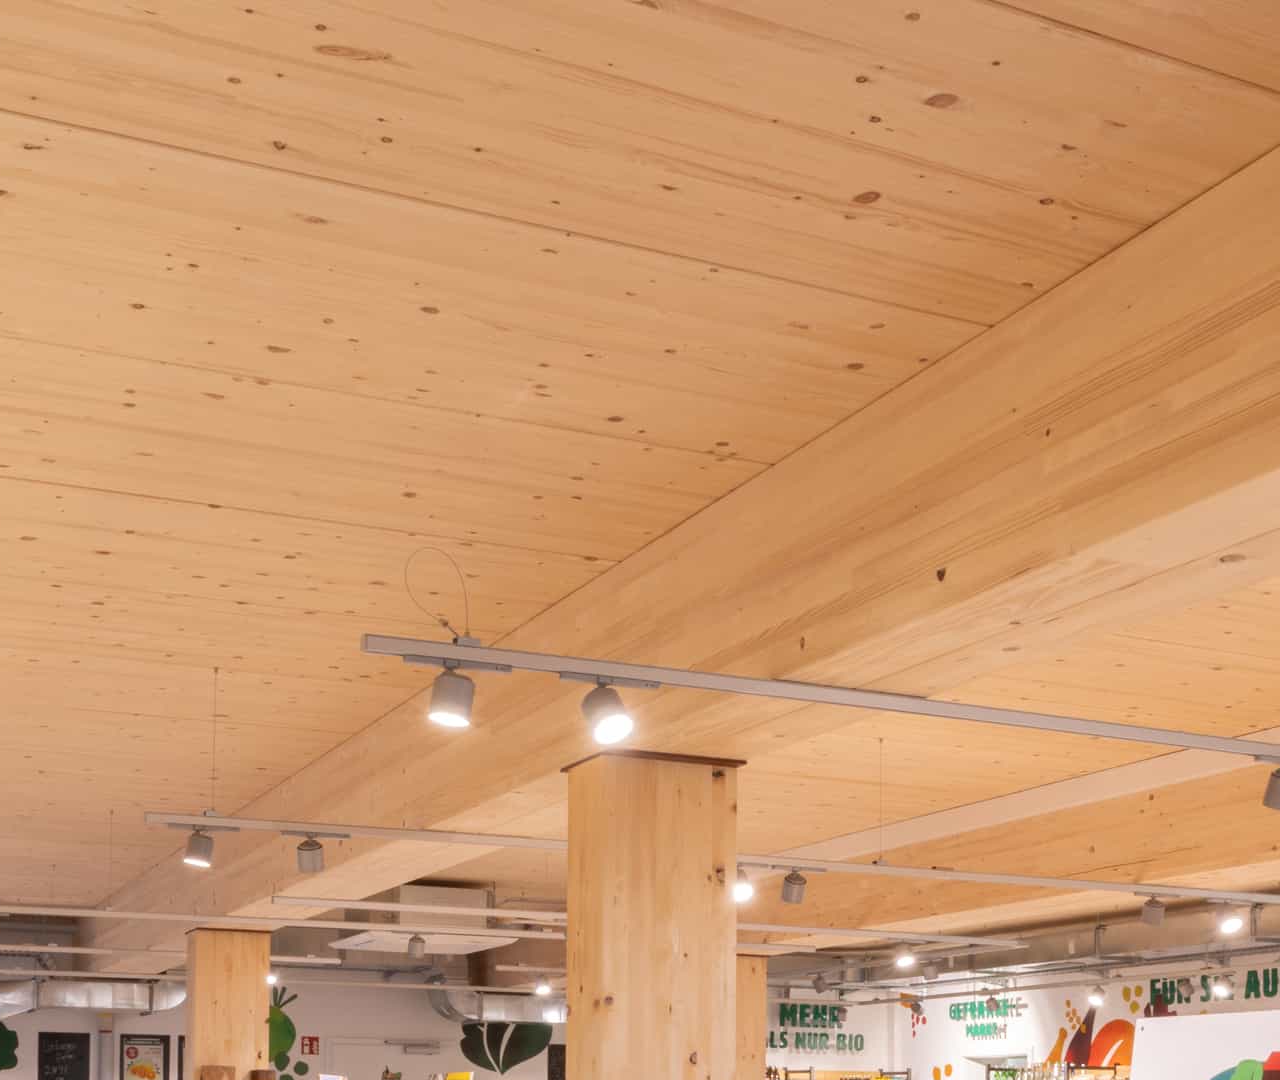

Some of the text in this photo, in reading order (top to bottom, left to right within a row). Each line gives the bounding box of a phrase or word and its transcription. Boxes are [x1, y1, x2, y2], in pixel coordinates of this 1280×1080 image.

[779, 1003, 843, 1029] MEHR
[795, 1032, 829, 1050] NUR
[836, 1033, 864, 1052] BIO
